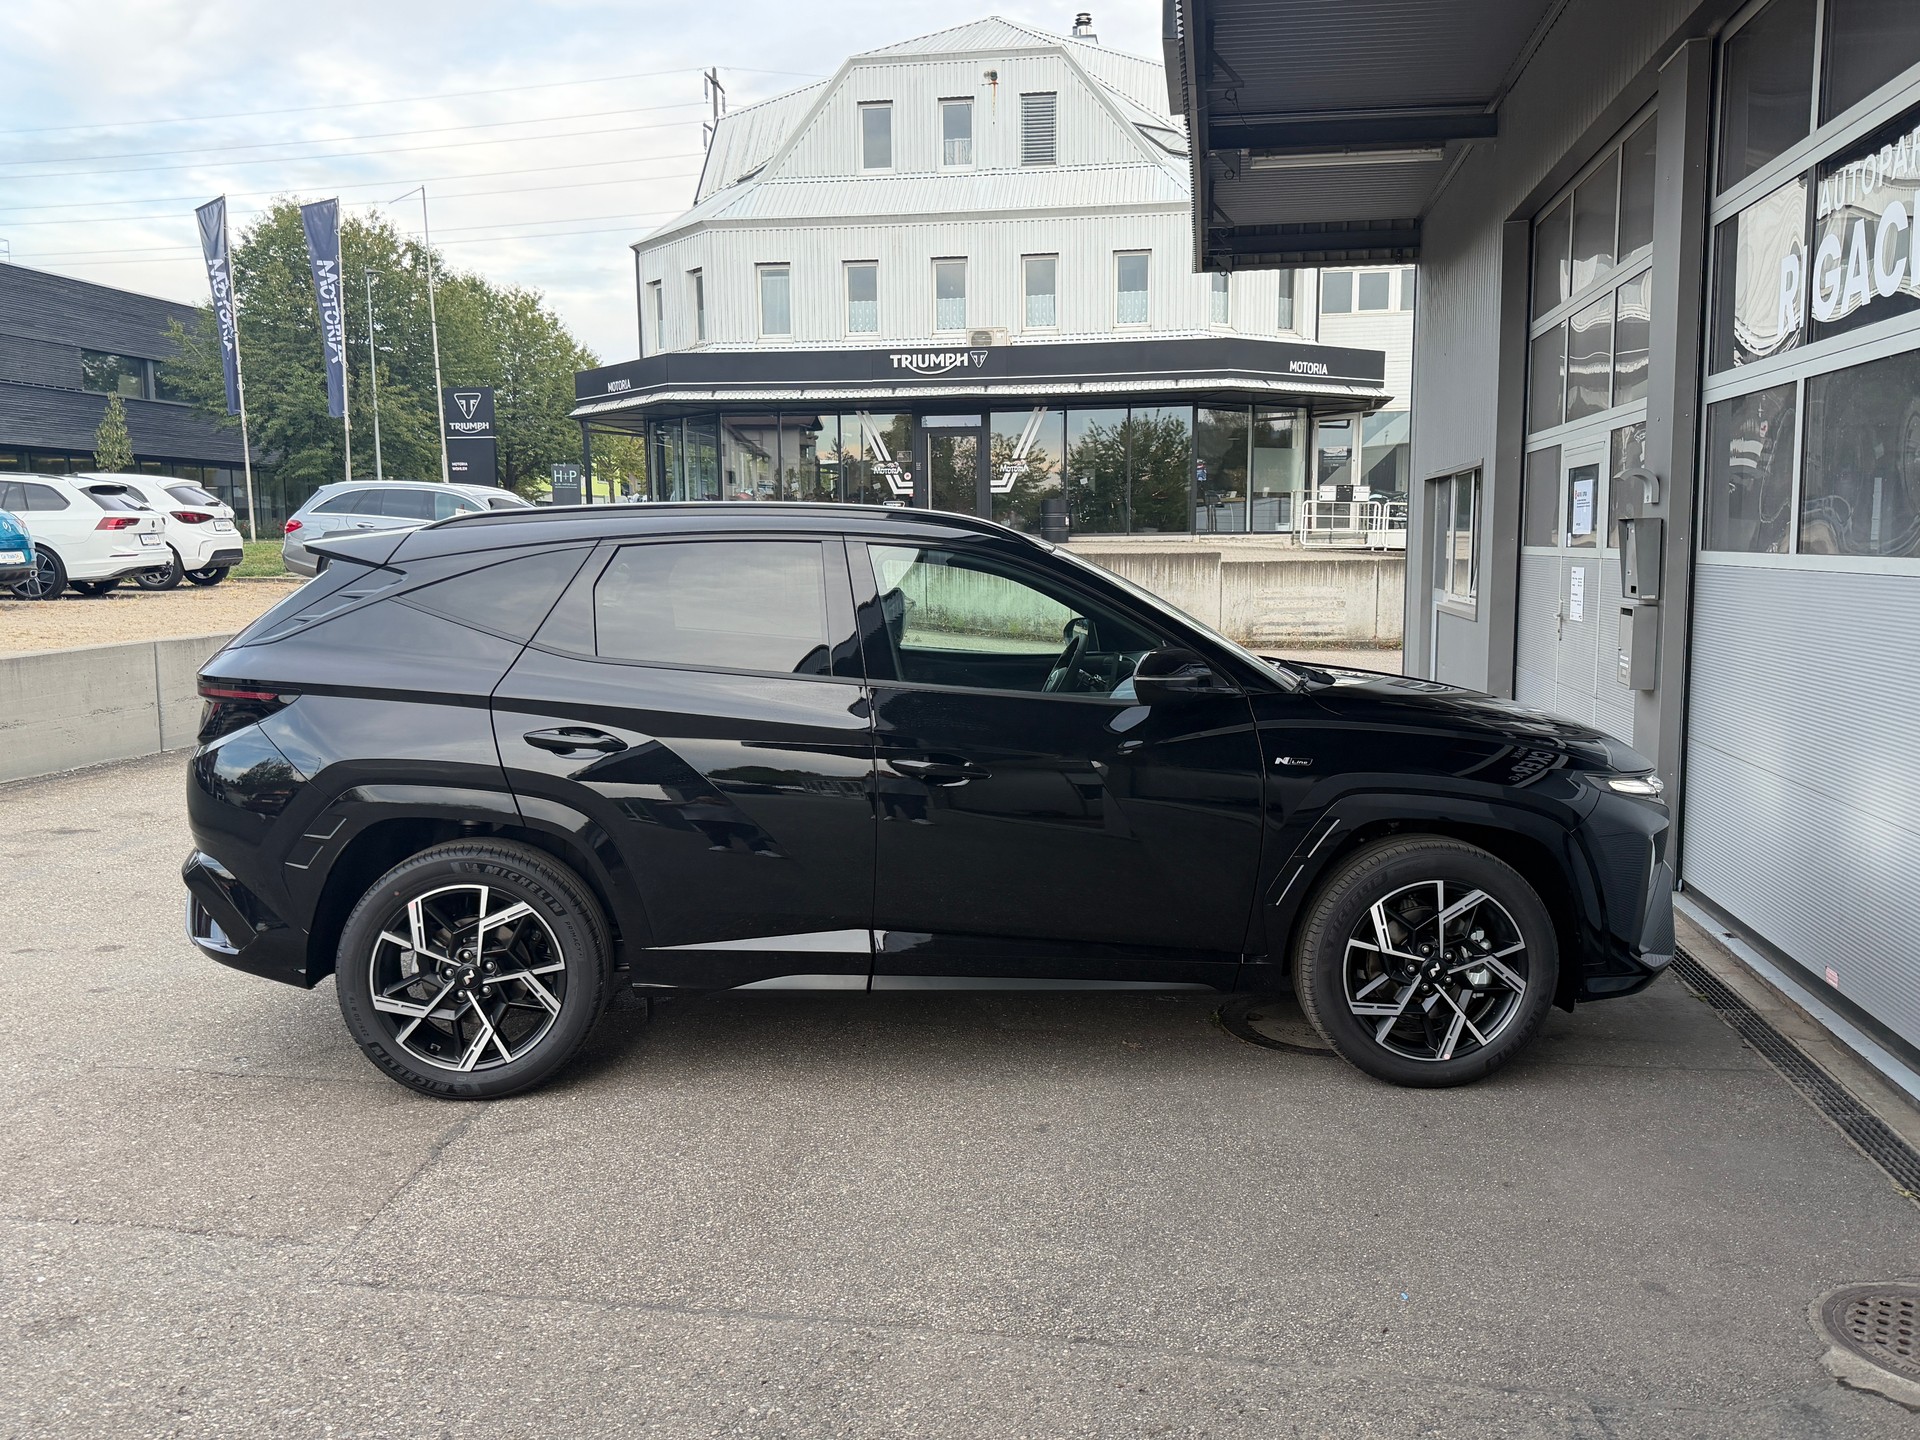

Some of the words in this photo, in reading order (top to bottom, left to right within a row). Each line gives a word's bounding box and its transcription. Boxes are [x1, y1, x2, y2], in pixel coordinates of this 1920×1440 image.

[316, 260, 344, 364] MOTORIA
[890, 353, 968, 374] TRIUMPH
[1290, 360, 1328, 375] MOTORIA
[607, 379, 631, 393] MOTORIA
[449, 422, 489, 433] TRIUMPH
[554, 470, 577, 482] H+P
[483, 865, 566, 917] MICHELIN
[564, 921, 583, 953] PRIMACY
[371, 1046, 451, 1094] MICHELIN
